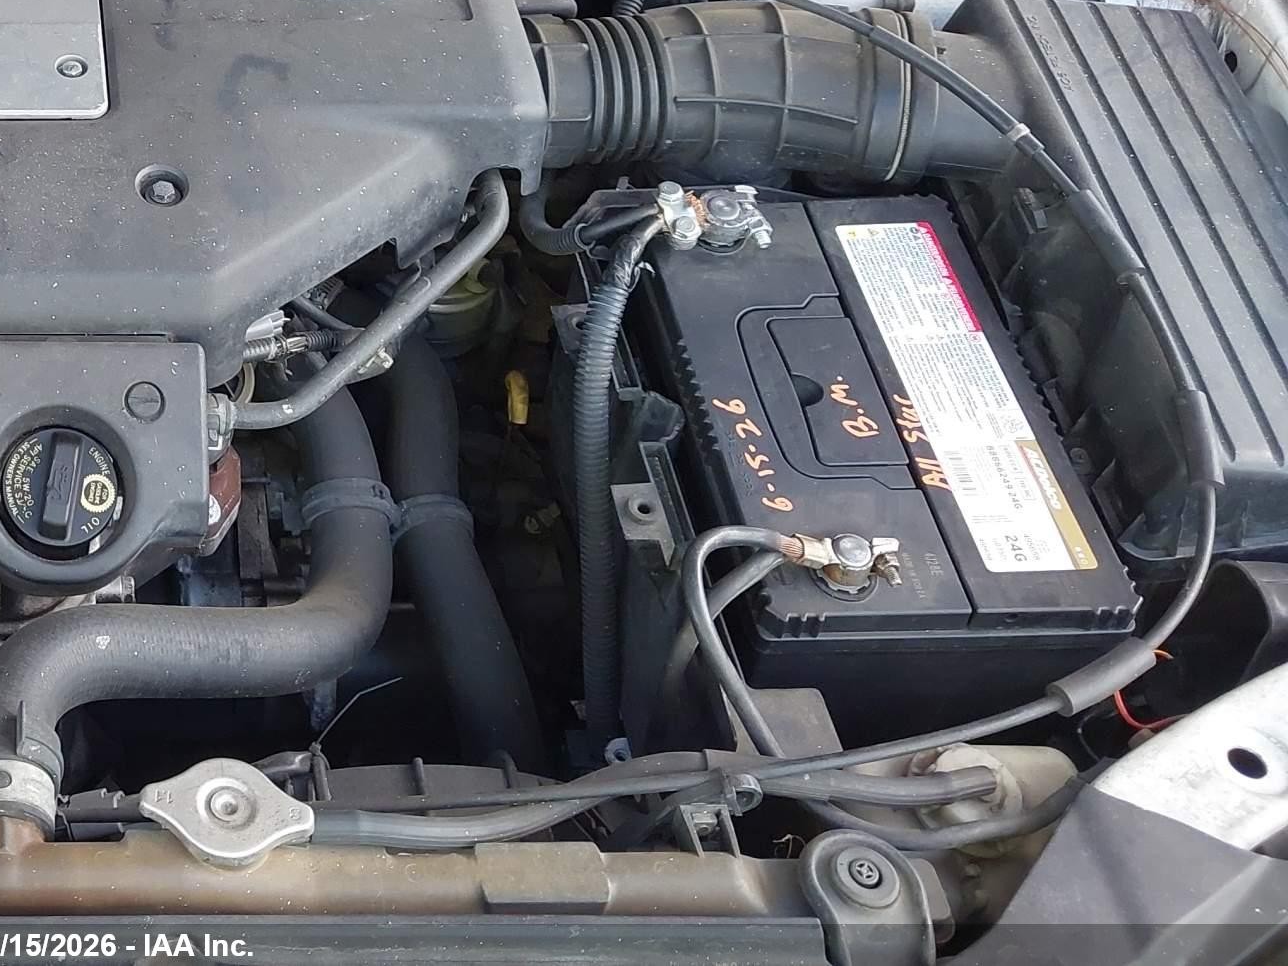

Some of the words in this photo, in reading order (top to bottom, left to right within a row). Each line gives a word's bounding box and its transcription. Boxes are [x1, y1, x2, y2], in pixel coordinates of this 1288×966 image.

[830, 375, 880, 438] B.M.
[18, 442, 31, 455] SEE
[29, 443, 43, 456] API
[88, 446, 111, 476] ENGINE
[5, 453, 20, 485] OWNER'S
[14, 455, 30, 490] SERVICE
[26, 456, 41, 474] SAE
[5, 486, 19, 516] MANUAL
[22, 477, 35, 506] 5W-20
[81, 517, 100, 534] OIL
[1004, 534, 1028, 562] 24G
